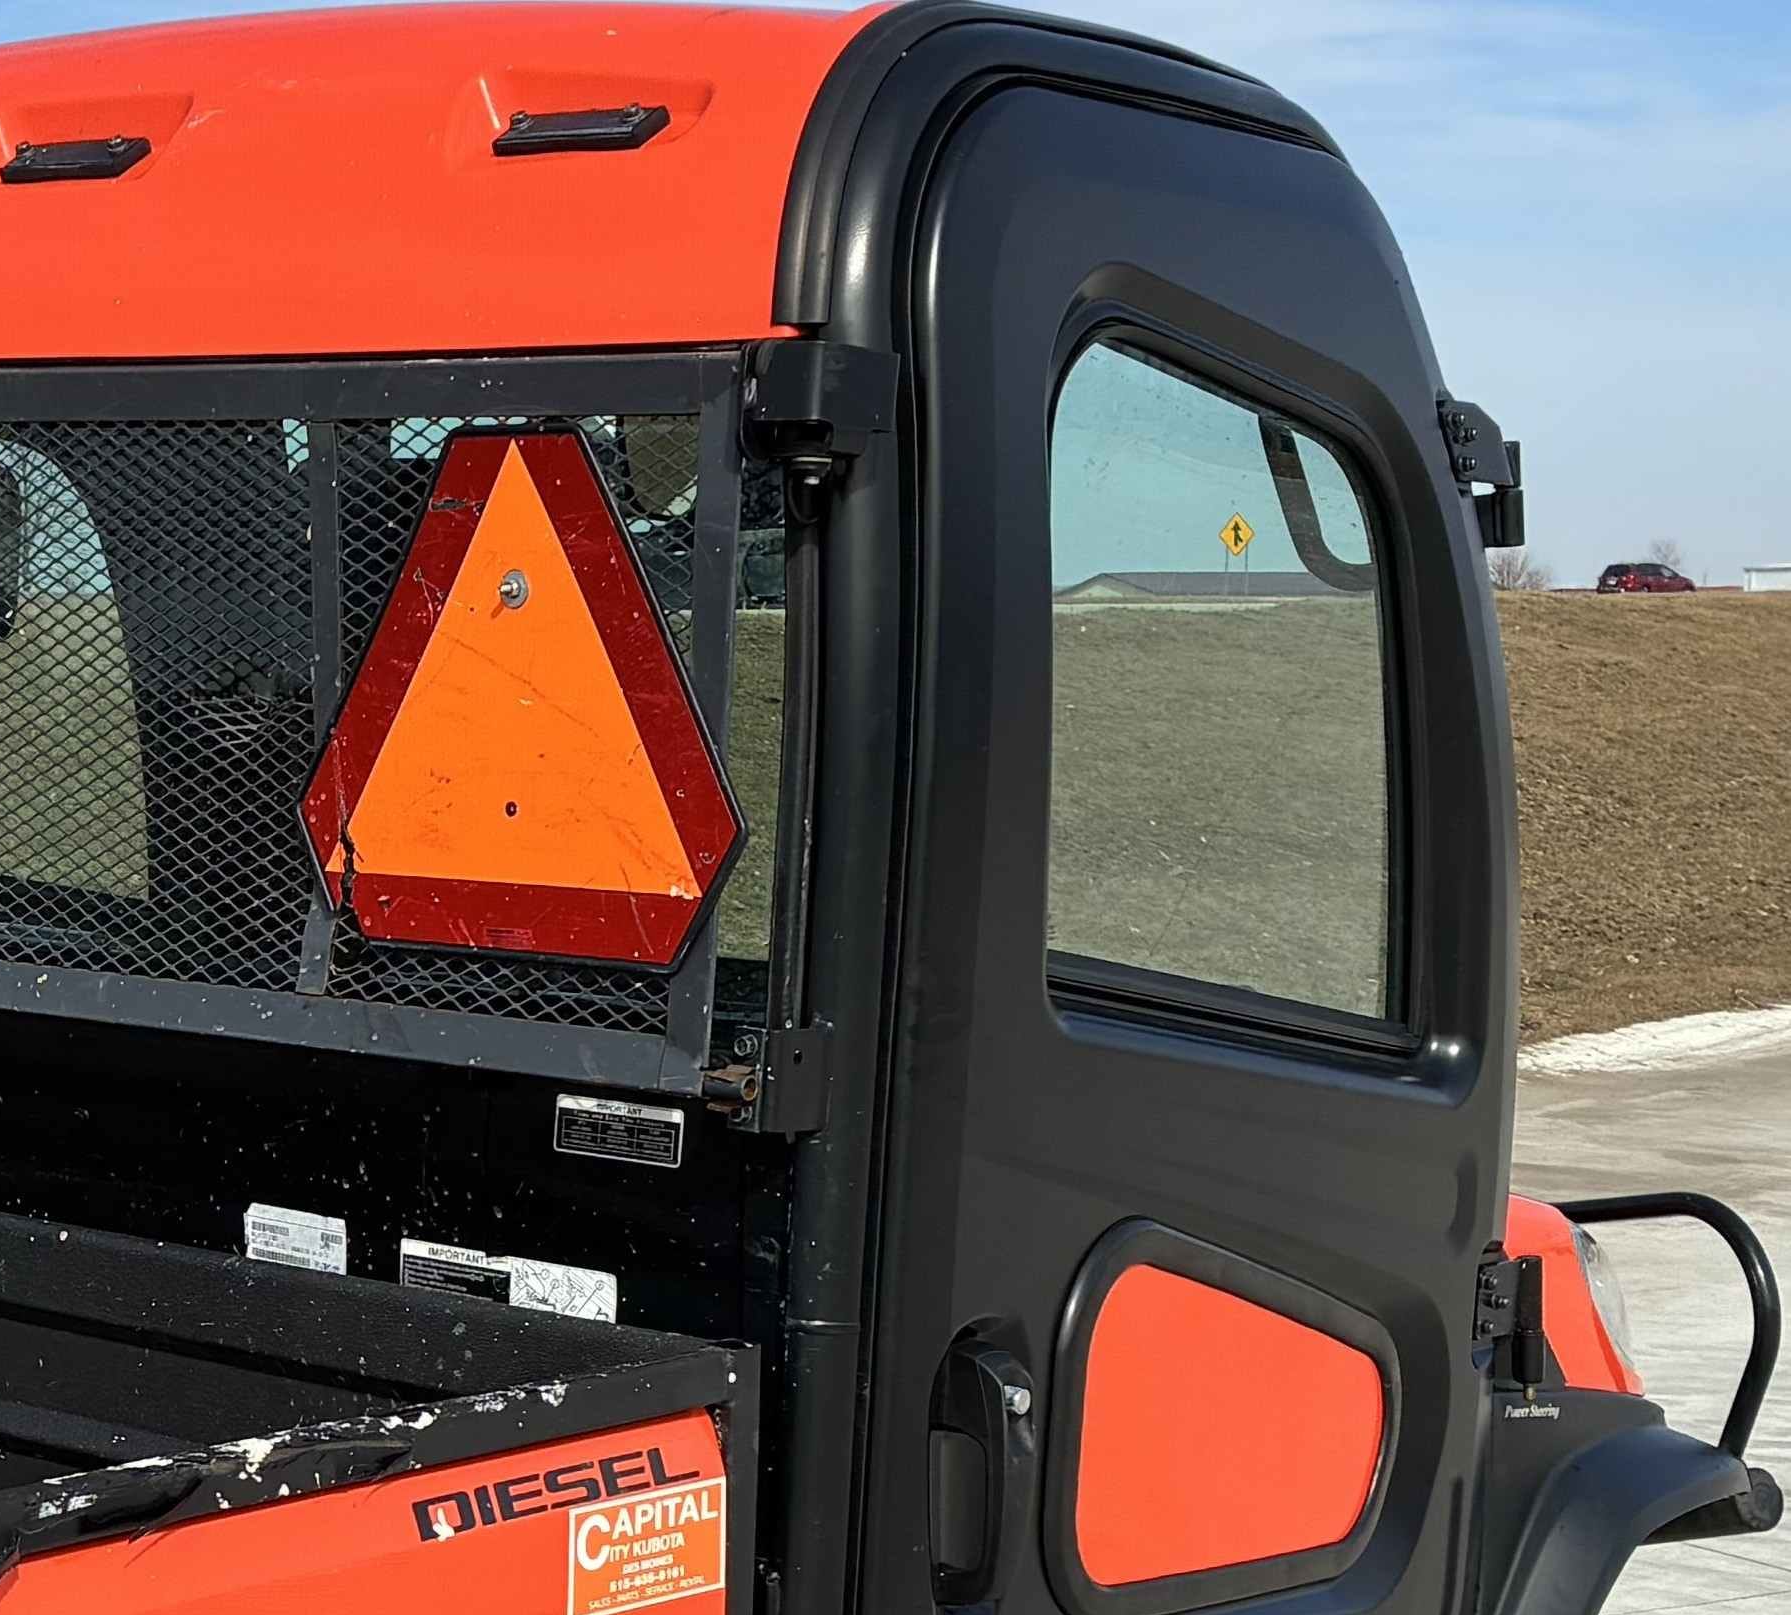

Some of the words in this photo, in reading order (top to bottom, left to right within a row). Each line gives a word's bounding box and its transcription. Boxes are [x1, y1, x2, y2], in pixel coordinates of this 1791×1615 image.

[427, 1245, 485, 1266] IMPORTANT
[411, 1447, 701, 1542] DIESEL
[576, 1490, 719, 1571] CAPITAL
[633, 1531, 685, 1557] KUBOTA
